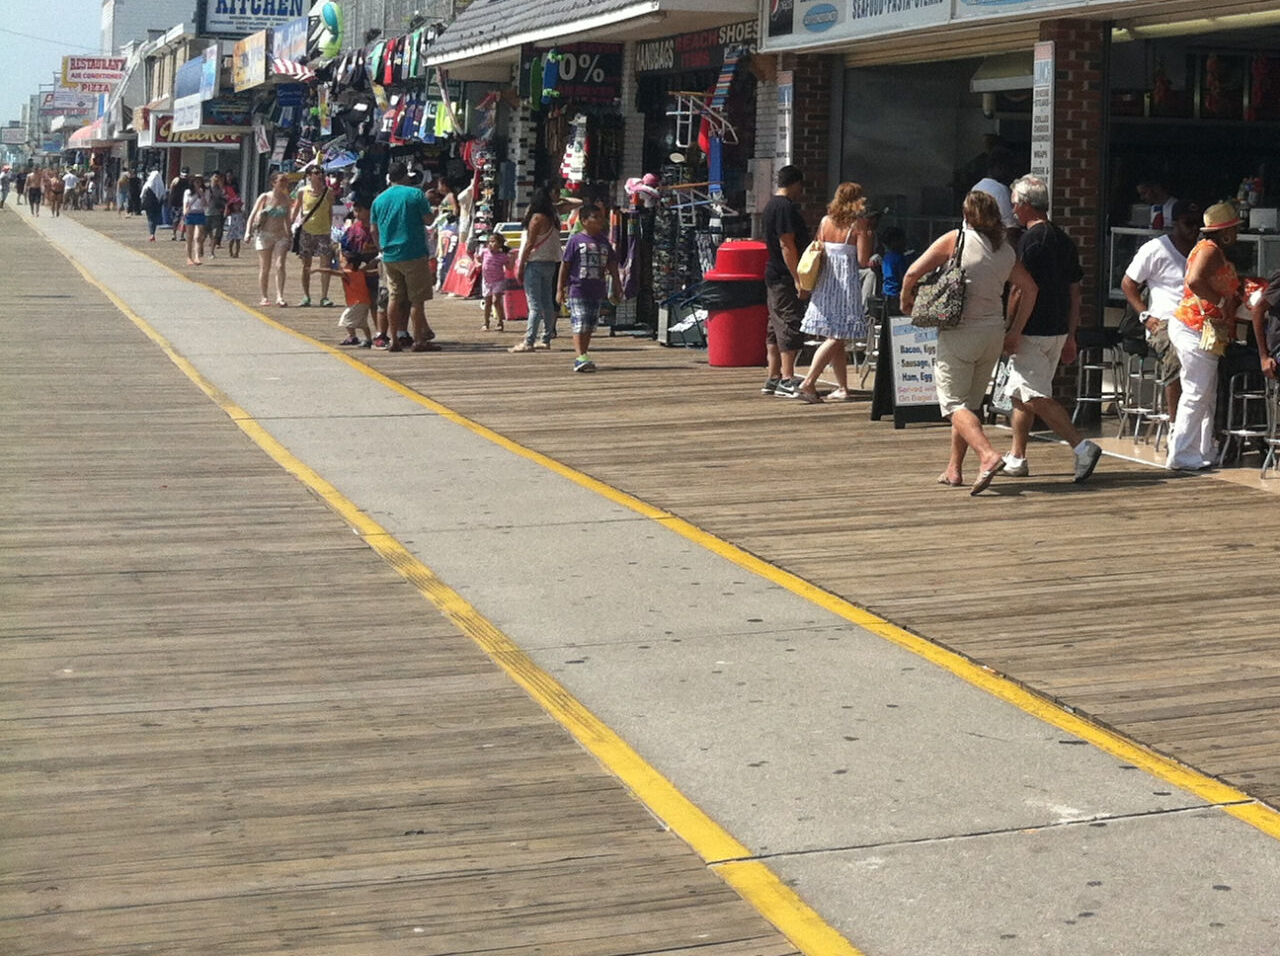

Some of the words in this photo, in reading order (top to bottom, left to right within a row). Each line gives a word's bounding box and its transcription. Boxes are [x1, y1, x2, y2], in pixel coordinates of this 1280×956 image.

[719, 21, 759, 45] SHOES
[81, 83, 110, 92] PIZZA
[920, 372, 933, 382] Egg
